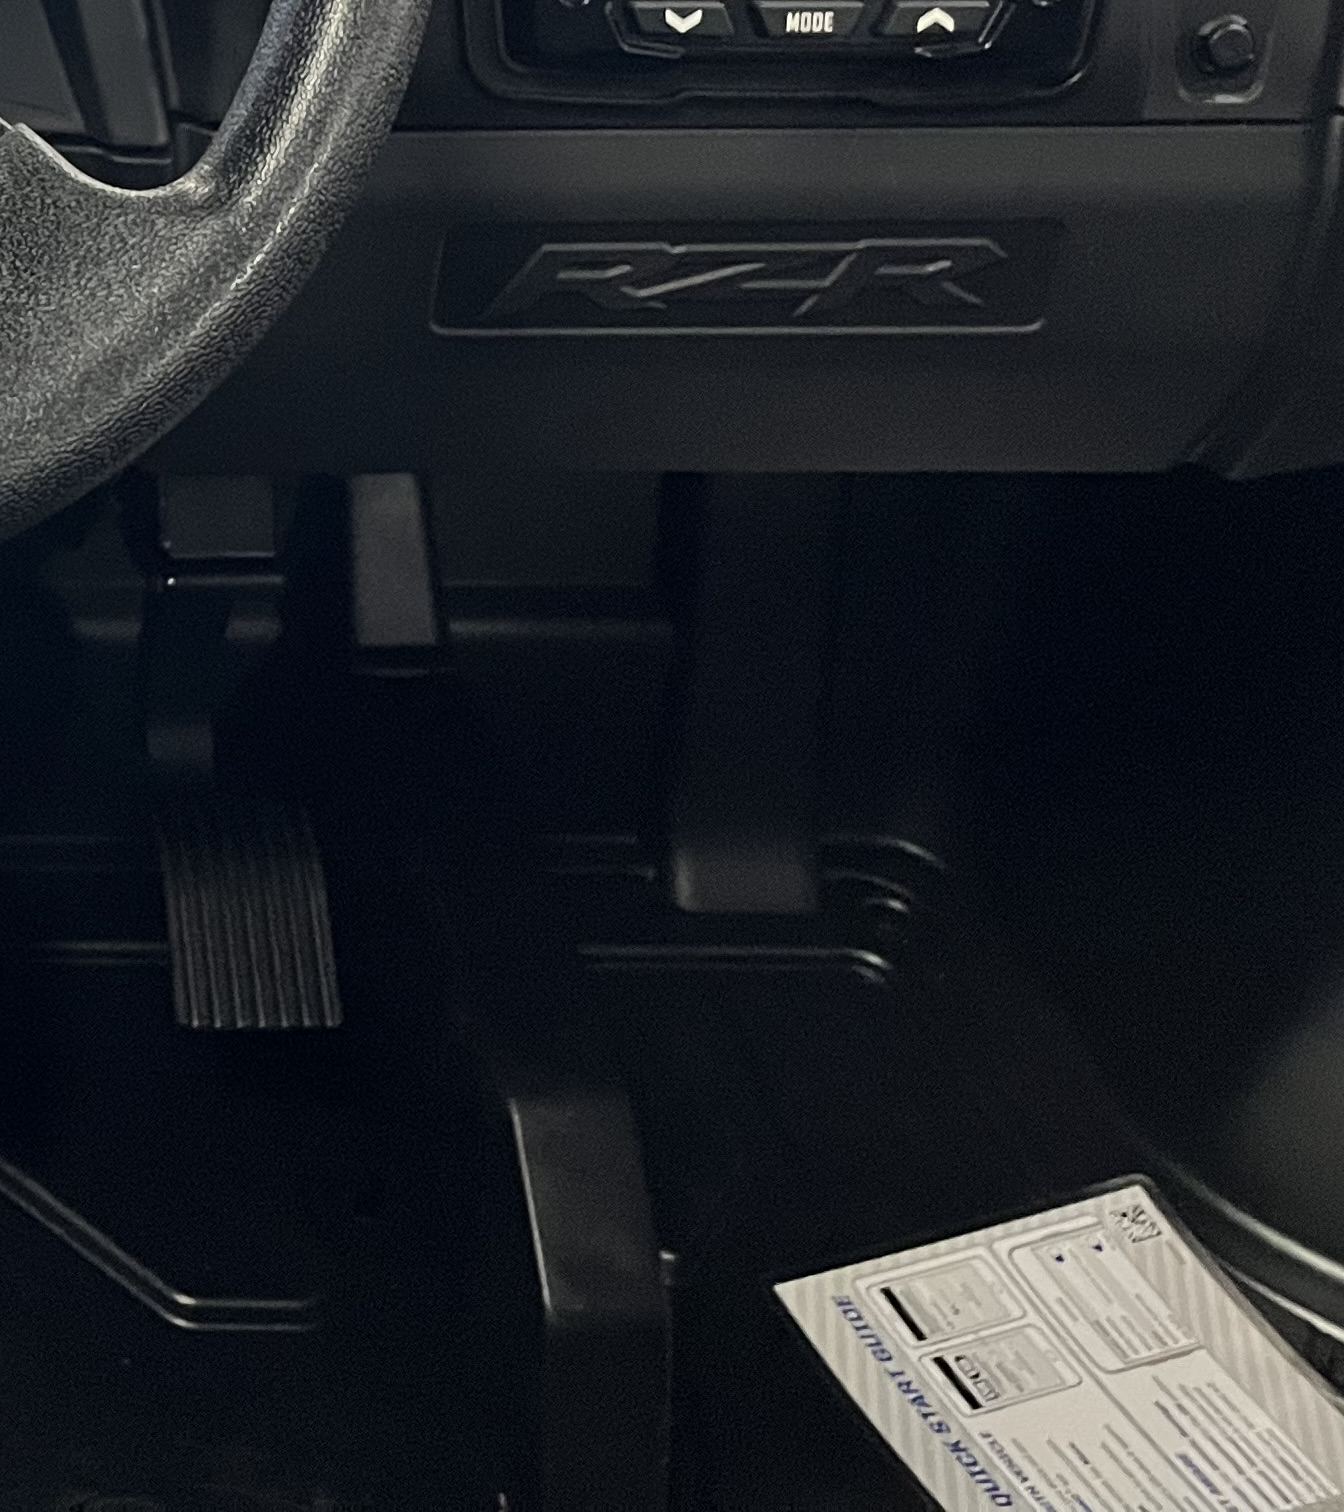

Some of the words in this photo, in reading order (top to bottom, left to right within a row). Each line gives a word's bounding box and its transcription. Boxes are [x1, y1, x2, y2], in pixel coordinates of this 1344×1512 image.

[785, 10, 834, 34] MODE
[831, 1295, 893, 1362] GUIDE
[884, 1368, 951, 1434] START
[942, 1440, 1013, 1507] QUICK
